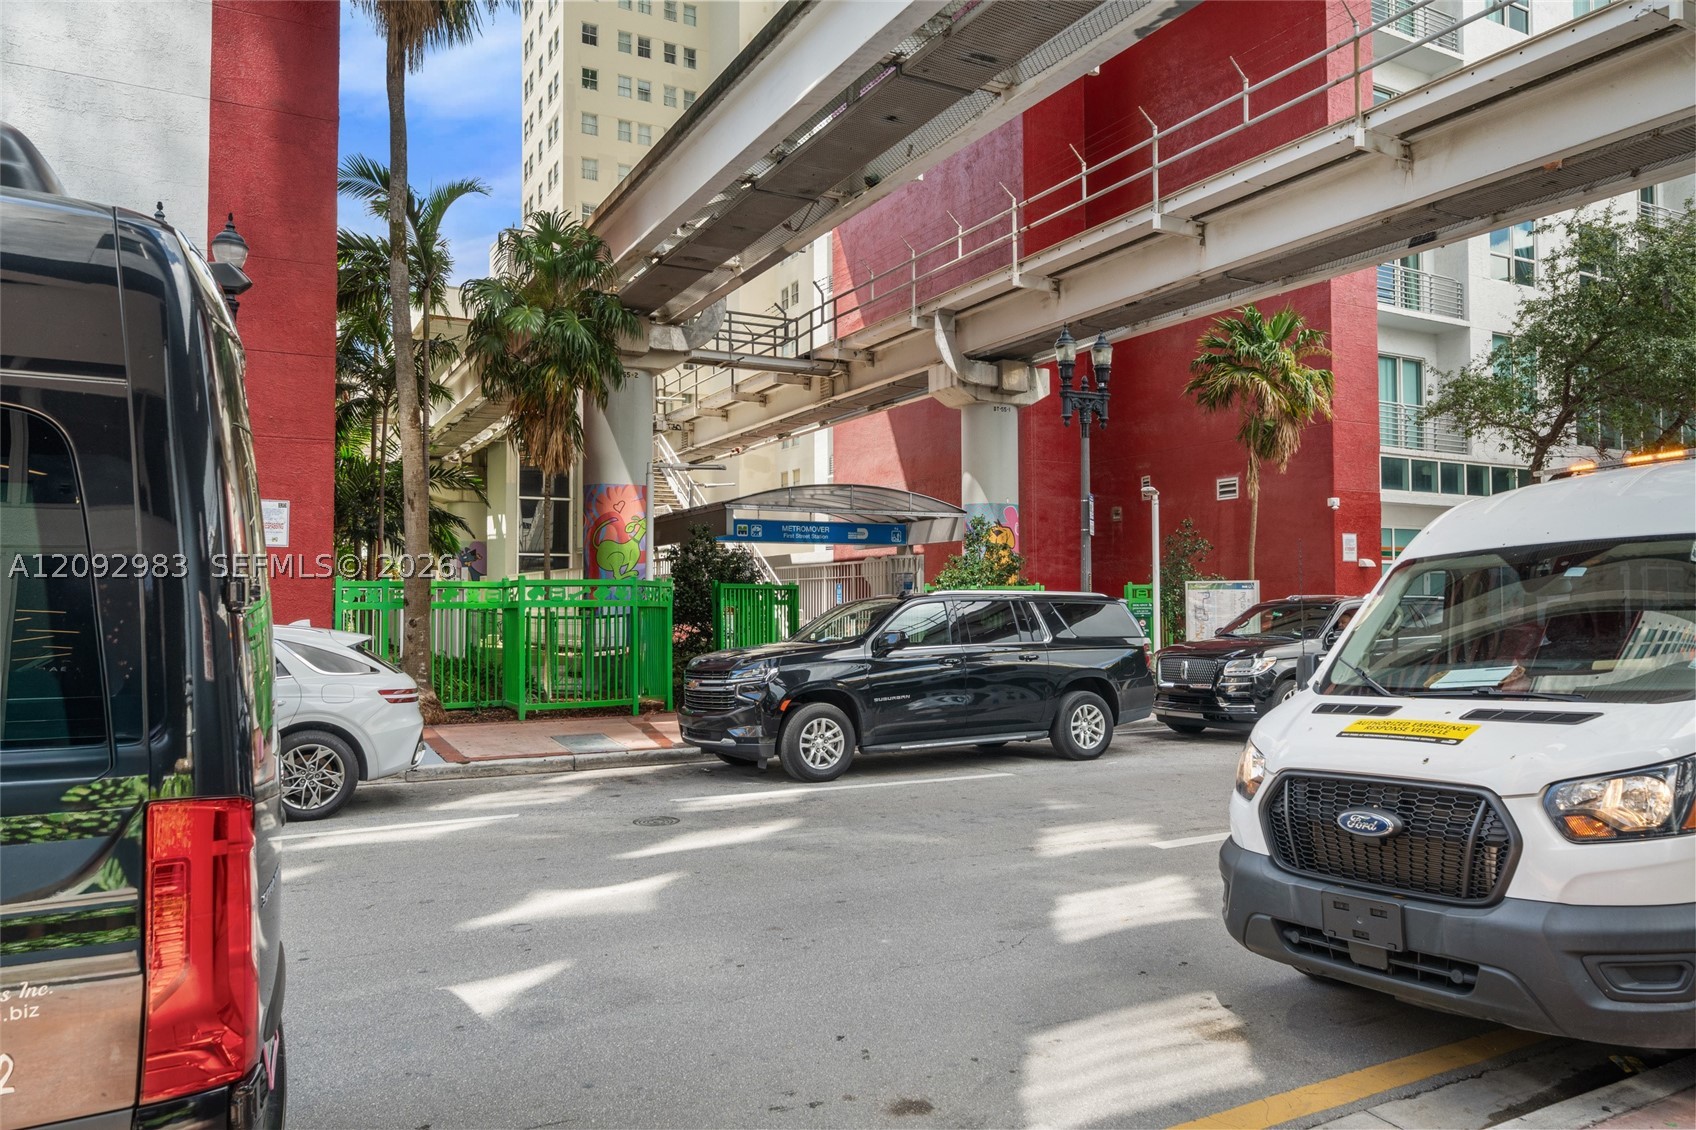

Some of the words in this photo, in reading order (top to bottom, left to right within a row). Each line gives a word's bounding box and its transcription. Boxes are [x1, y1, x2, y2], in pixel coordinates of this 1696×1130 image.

[781, 525, 830, 533] METROMOVER
[873, 694, 911, 702] SUBURBAN
[1355, 720, 1411, 728] AUTHORIZED
[1412, 721, 1472, 732] EMERGENCY
[1363, 725, 1411, 733] RESPONSE
[1411, 727, 1450, 736] VEHICLE
[1346, 814, 1378, 831] Ford
[0, 989, 12, 1002] s
[19, 981, 54, 999] Inc.
[0, 1003, 40, 1022] .biz
